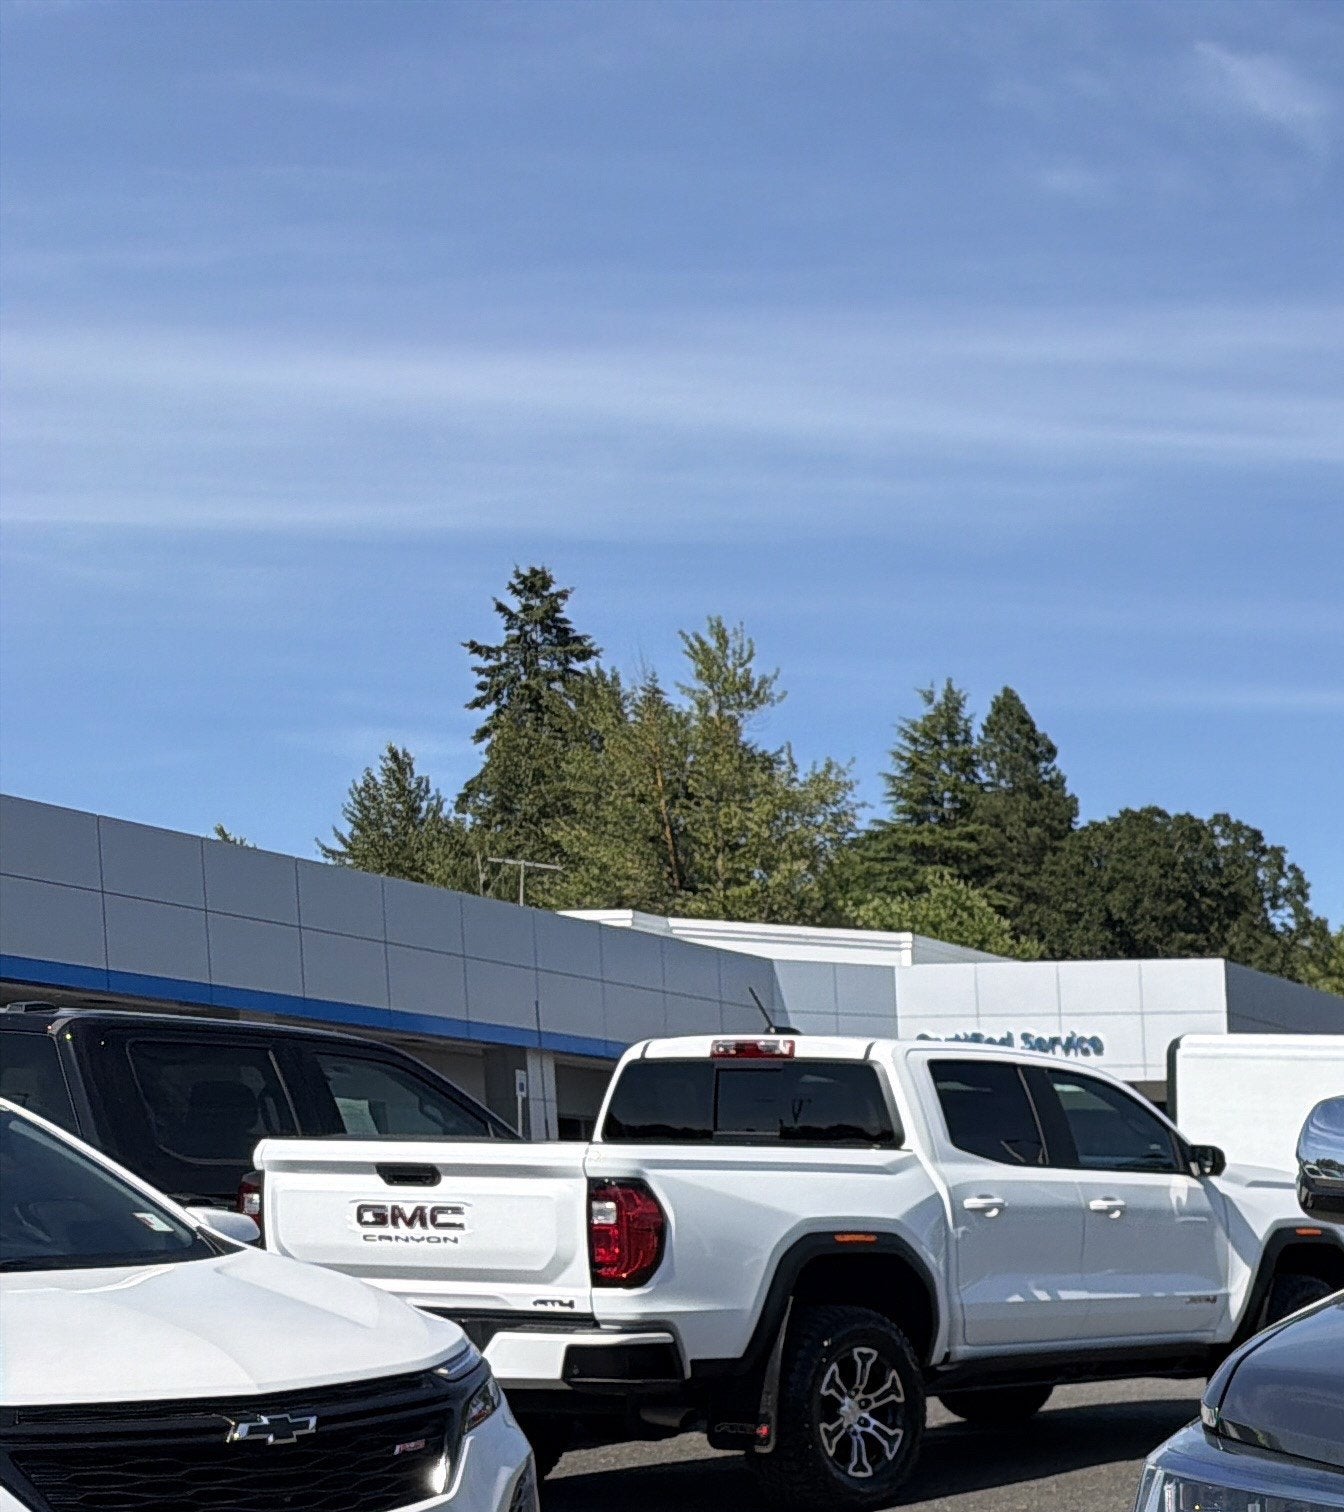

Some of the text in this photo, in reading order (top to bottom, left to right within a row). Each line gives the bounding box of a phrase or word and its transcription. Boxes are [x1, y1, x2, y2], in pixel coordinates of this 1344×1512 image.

[1020, 1031, 1104, 1057] Service
[356, 1204, 465, 1230] GMC
[362, 1234, 459, 1245] CANYON
